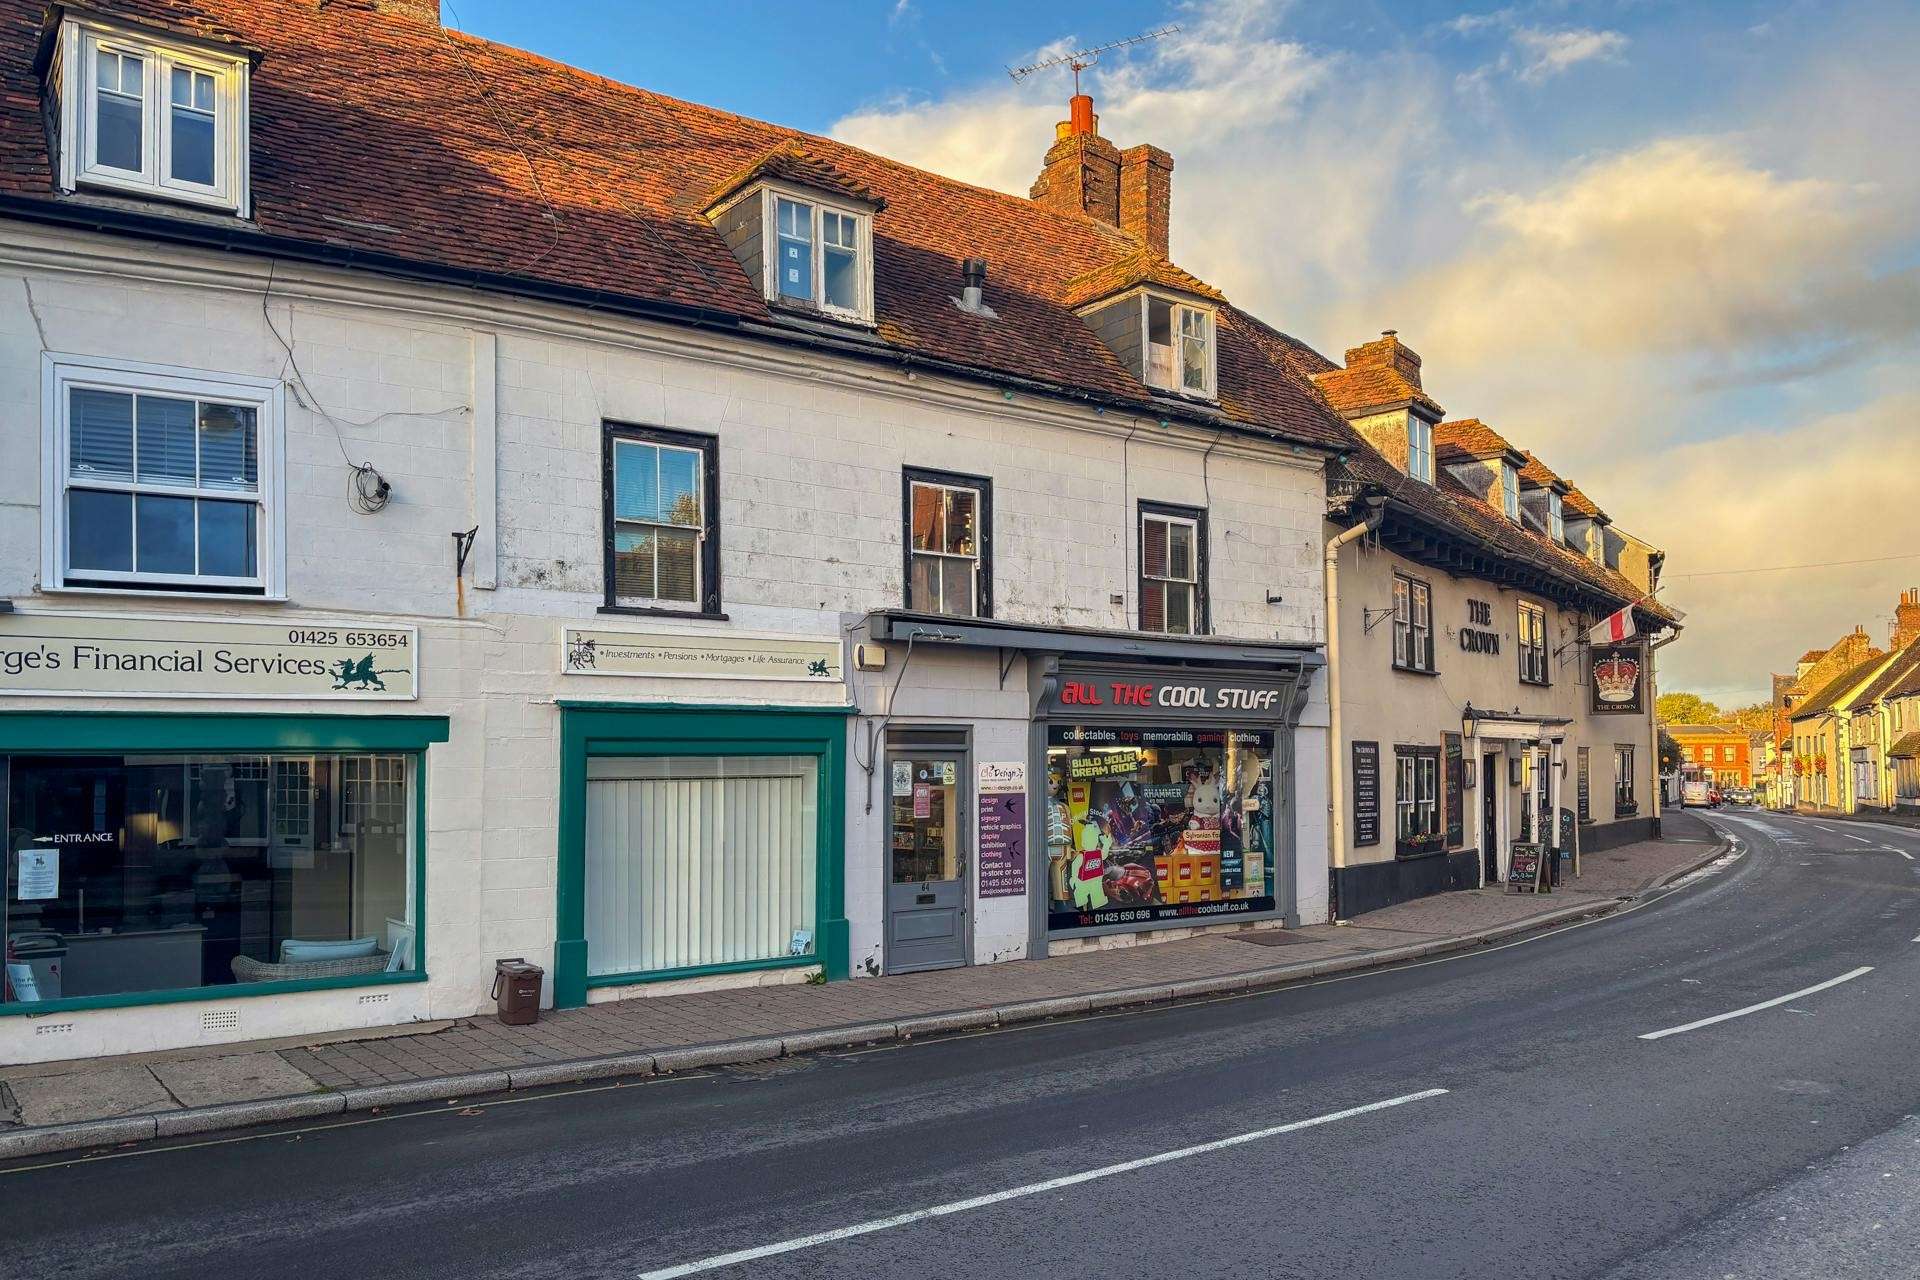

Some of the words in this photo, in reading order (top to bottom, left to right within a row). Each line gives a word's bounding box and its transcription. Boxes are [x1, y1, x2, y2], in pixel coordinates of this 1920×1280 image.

[1467, 599, 1491, 626] THE
[288, 630, 338, 645] 01425
[345, 634, 408, 648] 653654
[1460, 628, 1500, 655] CROWN
[73, 645, 203, 672] Financial
[214, 650, 326, 675] Services
[605, 649, 655, 660] Investments
[663, 651, 698, 661] Pensions
[705, 653, 745, 664] Mortgages
[752, 655, 766, 664] Life
[768, 655, 805, 665] Assurance
[1111, 683, 1153, 706] THE
[1158, 686, 1210, 708] COOL
[1216, 688, 1279, 710] STUFF
[1063, 730, 1116, 741] collectables
[1120, 731, 1139, 743] toys
[1143, 732, 1193, 742] memorabilia
[1229, 733, 1260, 745] clothing
[1072, 757, 1101, 768] BUILD
[1104, 752, 1136, 765] YOUR
[1072, 766, 1108, 778] DREAM
[1111, 761, 1138, 774] RIDE
[981, 797, 999, 805] design
[981, 806, 994, 814] print
[1000, 823, 1022, 832] graphics
[54, 833, 114, 843] ENTRANCE
[981, 833, 1000, 841] display
[981, 841, 1007, 849] exhibition
[981, 861, 1004, 870] Contact
[921, 882, 930, 892] 64
[1001, 878, 1013, 886] 650
[1079, 915, 1093, 925] Tel:
[1095, 913, 1119, 923] 01425
[1120, 911, 1135, 921] 650
[1136, 910, 1151, 919] 696
